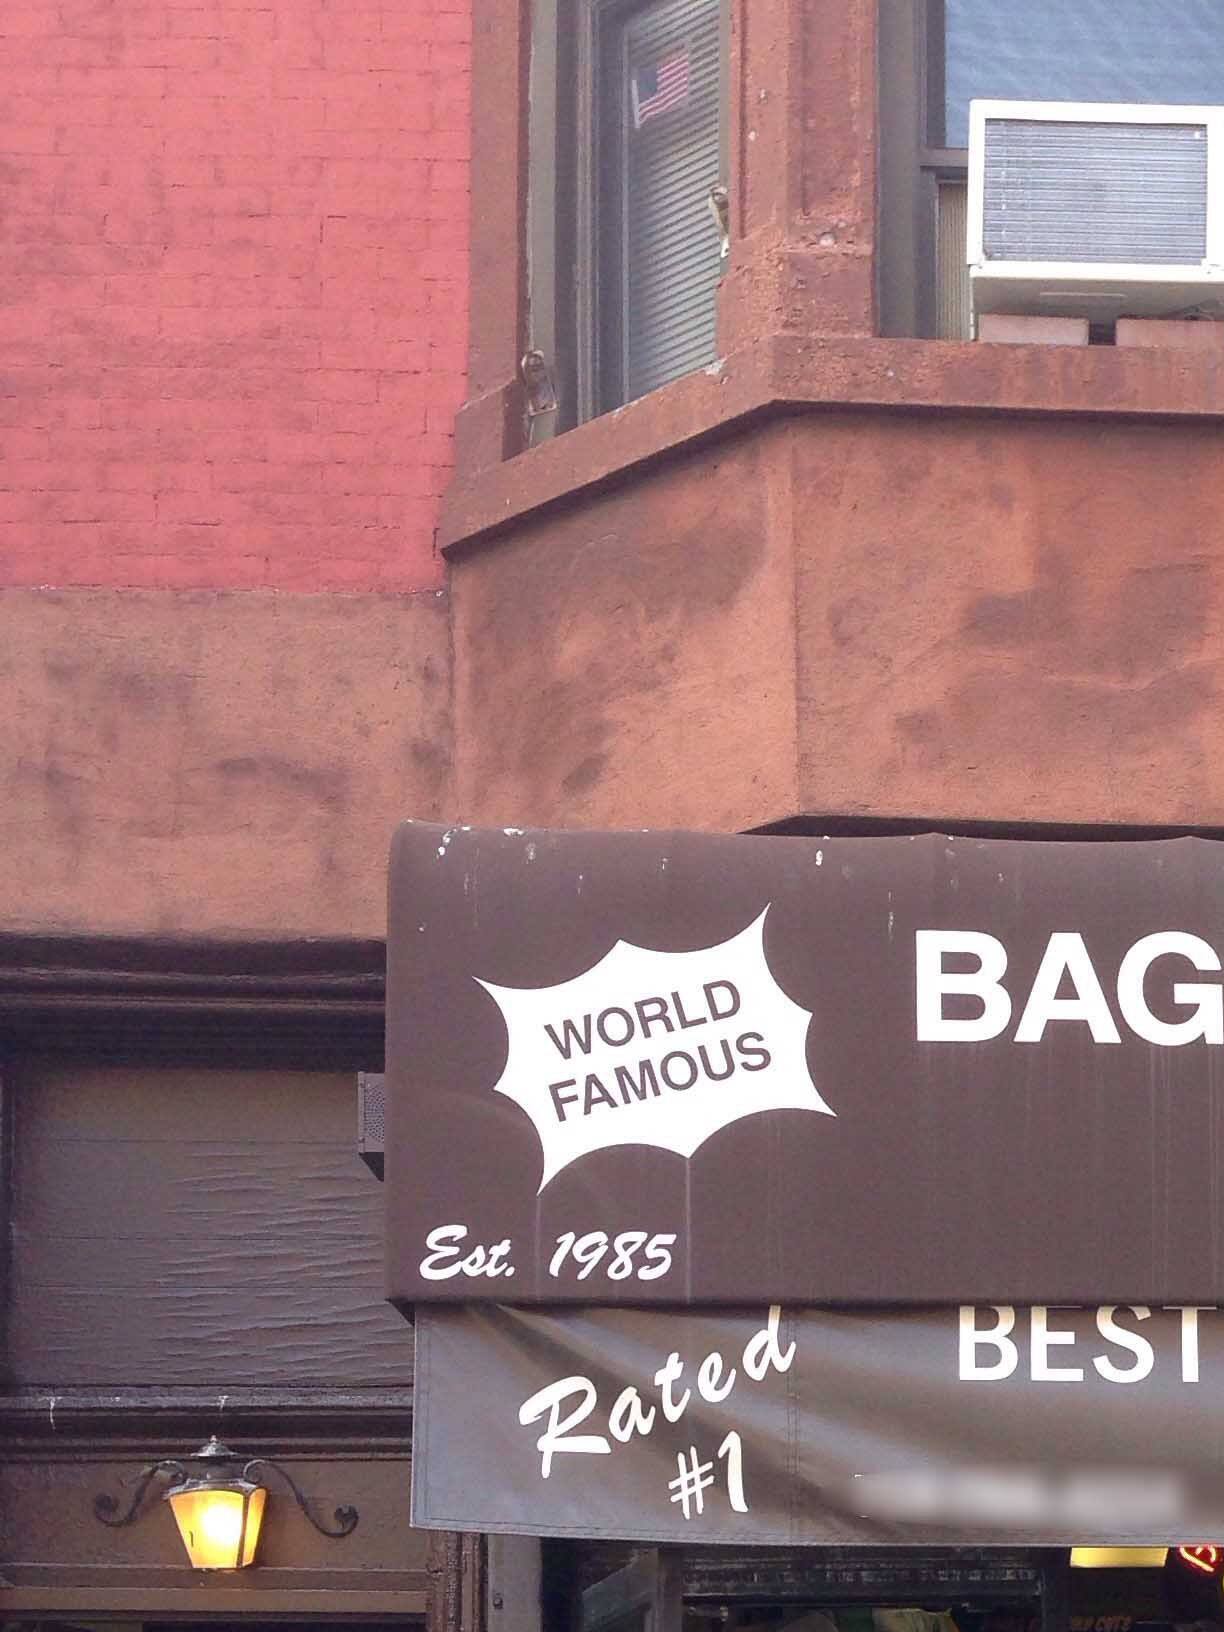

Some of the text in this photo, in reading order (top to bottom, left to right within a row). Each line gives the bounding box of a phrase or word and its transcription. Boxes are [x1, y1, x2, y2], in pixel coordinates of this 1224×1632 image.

[544, 979, 742, 1060] WORLD
[549, 1032, 771, 1122] FAMOUS
[419, 1224, 677, 1281] Est. 1985
[956, 1306, 1217, 1384] BEST
[518, 1306, 797, 1479] Rated
[668, 1430, 749, 1521] #1
